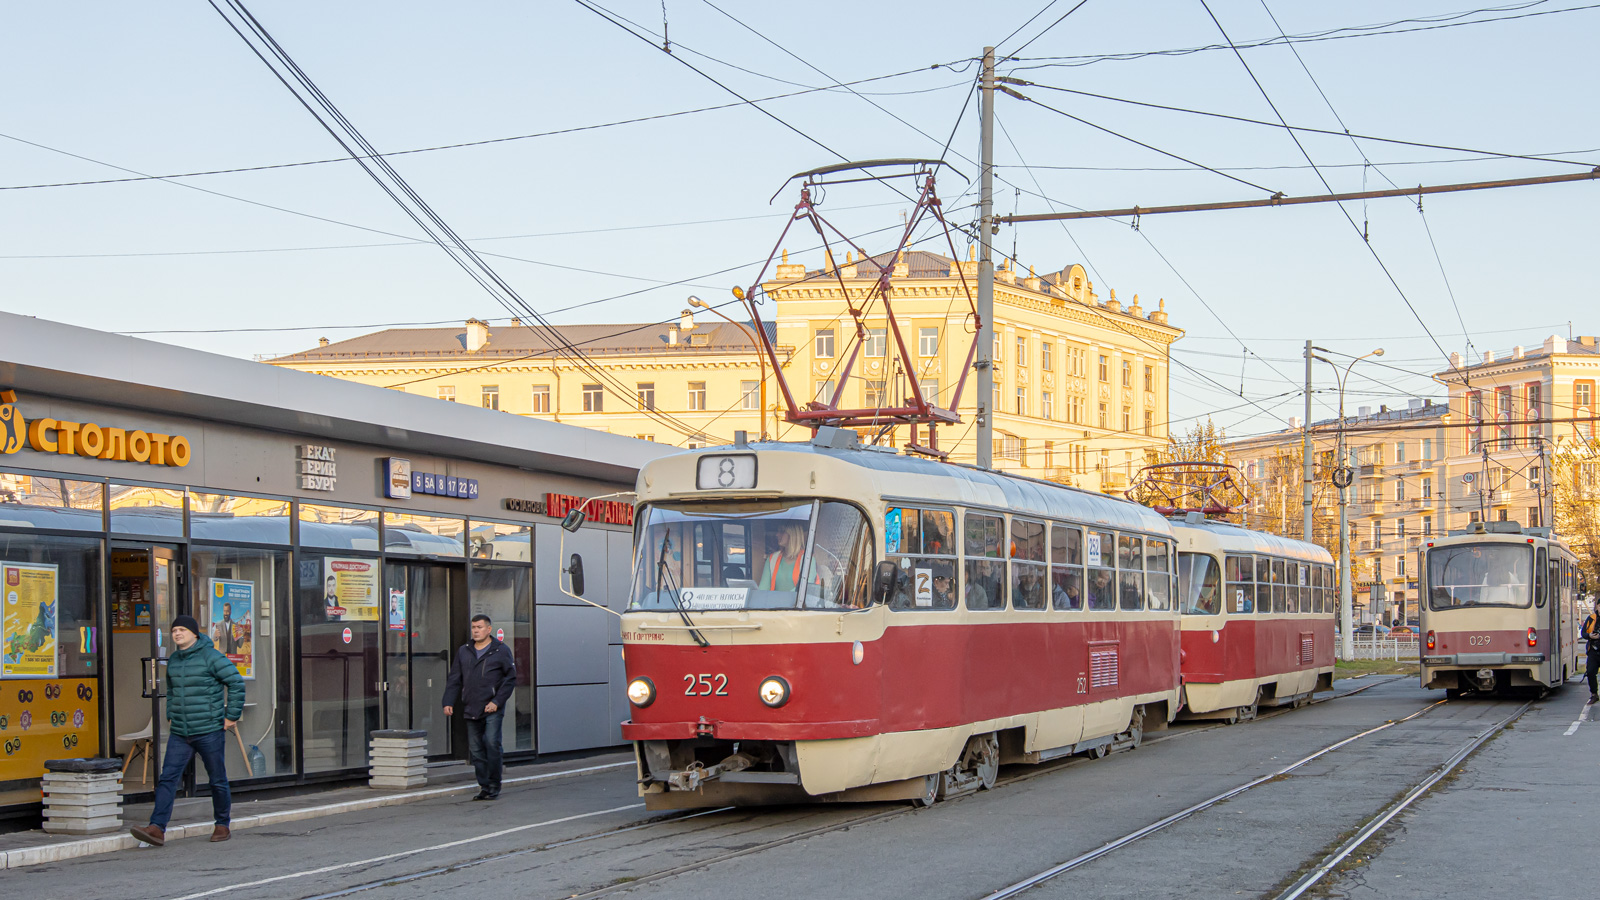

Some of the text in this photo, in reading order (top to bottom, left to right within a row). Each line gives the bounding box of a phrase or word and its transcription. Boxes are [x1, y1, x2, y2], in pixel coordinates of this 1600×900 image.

[29, 418, 191, 467] СТОЛОТО
[303, 445, 336, 461] ЕКАТ
[303, 460, 336, 476] ЕРИН
[718, 458, 735, 488] 8
[303, 475, 336, 491] БУРГ
[415, 476, 421, 488] 5
[438, 479, 444, 490] 8
[448, 480, 456, 492] 17
[459, 482, 467, 493] 22
[469, 483, 478, 494] 24
[589, 499, 634, 526] УРАЛМА
[917, 573, 930, 594] 2
[682, 591, 694, 609] 8
[1469, 635, 1491, 646] 029
[683, 673, 729, 697] 252
[1076, 677, 1086, 694] 252
